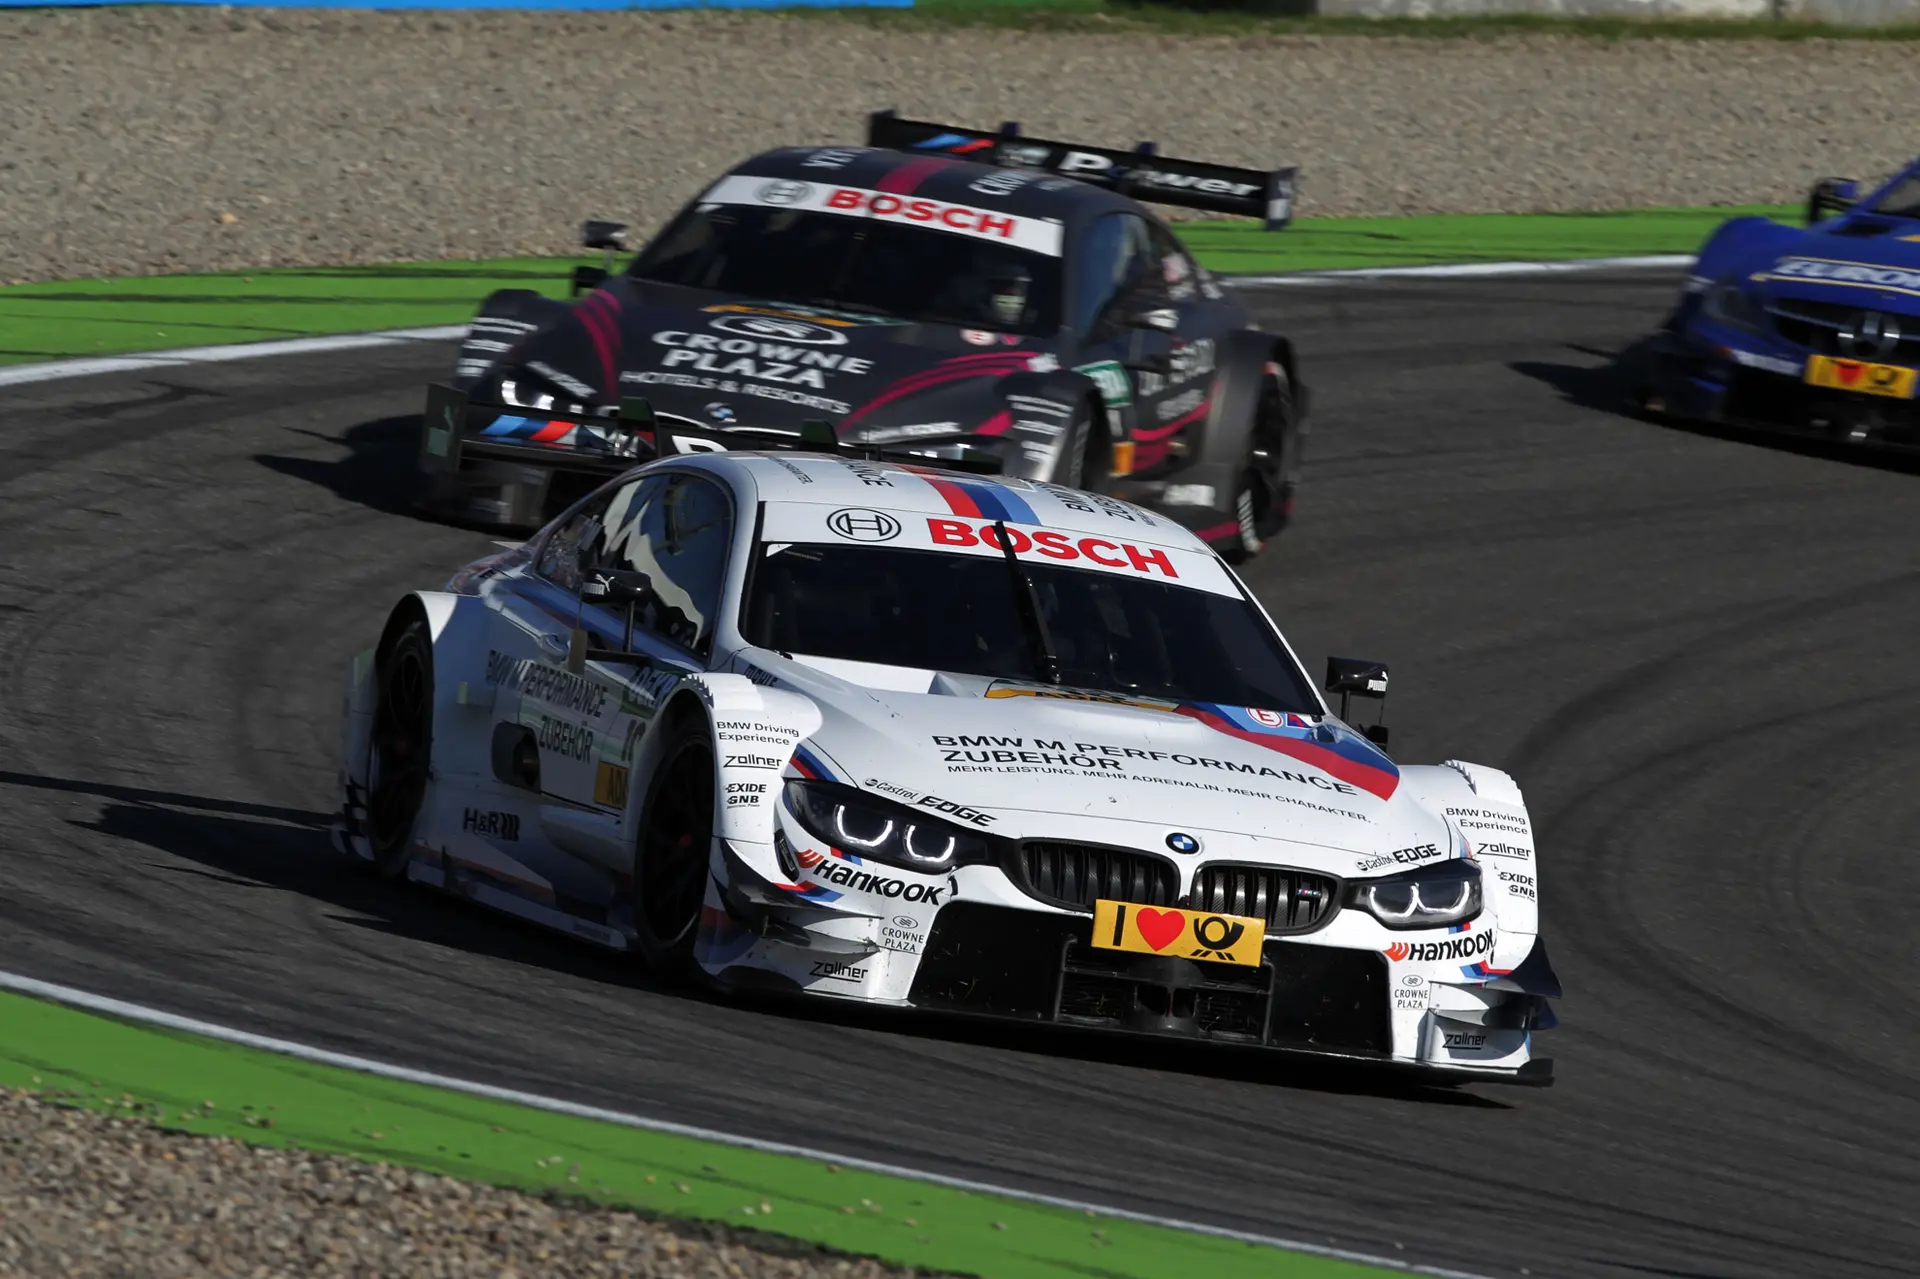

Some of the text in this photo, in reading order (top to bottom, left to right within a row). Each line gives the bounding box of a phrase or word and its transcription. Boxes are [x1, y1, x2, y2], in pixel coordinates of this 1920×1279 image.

[826, 188, 1016, 238] BOSCH
[651, 330, 874, 374] CROWNE
[661, 349, 826, 389] PLAZA
[926, 517, 1179, 578] BOSCH
[716, 721, 799, 737] BMW Driving
[719, 732, 790, 745] Experience
[539, 715, 594, 764] ZUBEHÖR
[931, 735, 1358, 796] BMW M PERFORMANCE
[940, 749, 1124, 771] ZUBEHÖR
[725, 782, 767, 794] EXIDE
[947, 765, 1371, 823] MEHR LEISTUNG. MEHR ADRENALIN. MEHR CHARAKTER.
[727, 795, 760, 805] GNB
[876, 780, 999, 826] Castrol EDGE
[1445, 807, 1527, 826] BMW Driving
[1460, 818, 1528, 835] Experience
[1392, 843, 1441, 864] EDGE
[1497, 871, 1534, 888] EXIDE
[1508, 884, 1536, 898] GNB
[881, 926, 925, 944] CROWNE
[1112, 905, 1126, 946] I
[884, 938, 917, 953] PLAZA
[1394, 989, 1428, 999] CROWNE
[1397, 999, 1423, 1009] PLAZA
